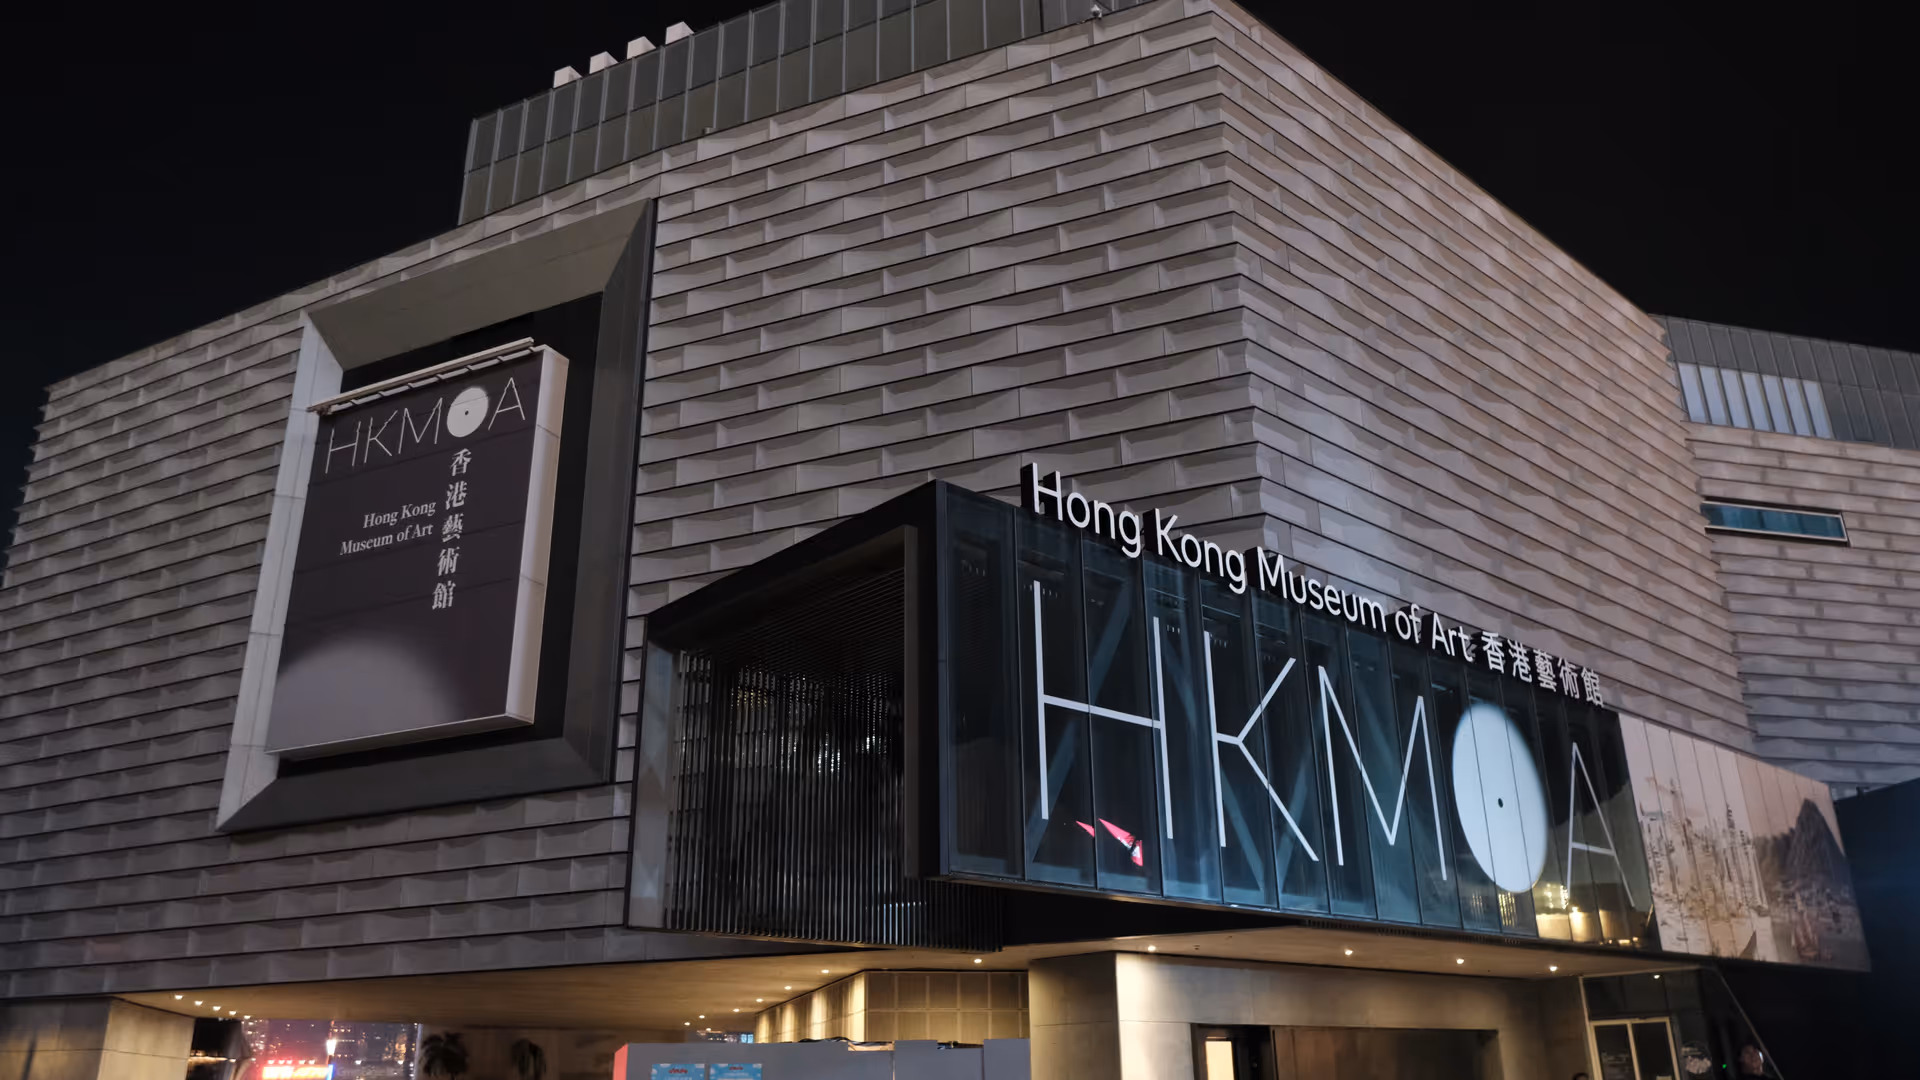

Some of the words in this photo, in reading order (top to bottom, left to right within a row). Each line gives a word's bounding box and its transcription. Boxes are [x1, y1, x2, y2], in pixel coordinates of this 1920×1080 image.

[326, 378, 525, 450] HKMOA
[341, 534, 393, 556] Museum
[397, 528, 413, 541] of
[411, 524, 433, 538] Art
[363, 512, 398, 530] Hong
[400, 501, 436, 518] Kong
[432, 448, 472, 611] 香港藝術館
[1031, 463, 1141, 558] Hong
[1153, 508, 1247, 594] Kong
[1257, 547, 1386, 632] Museum
[1394, 603, 1421, 644] of
[1430, 615, 1473, 662] Art
[1481, 630, 1604, 706] 香港藝術館
[1033, 580, 1634, 908] HKMOA
